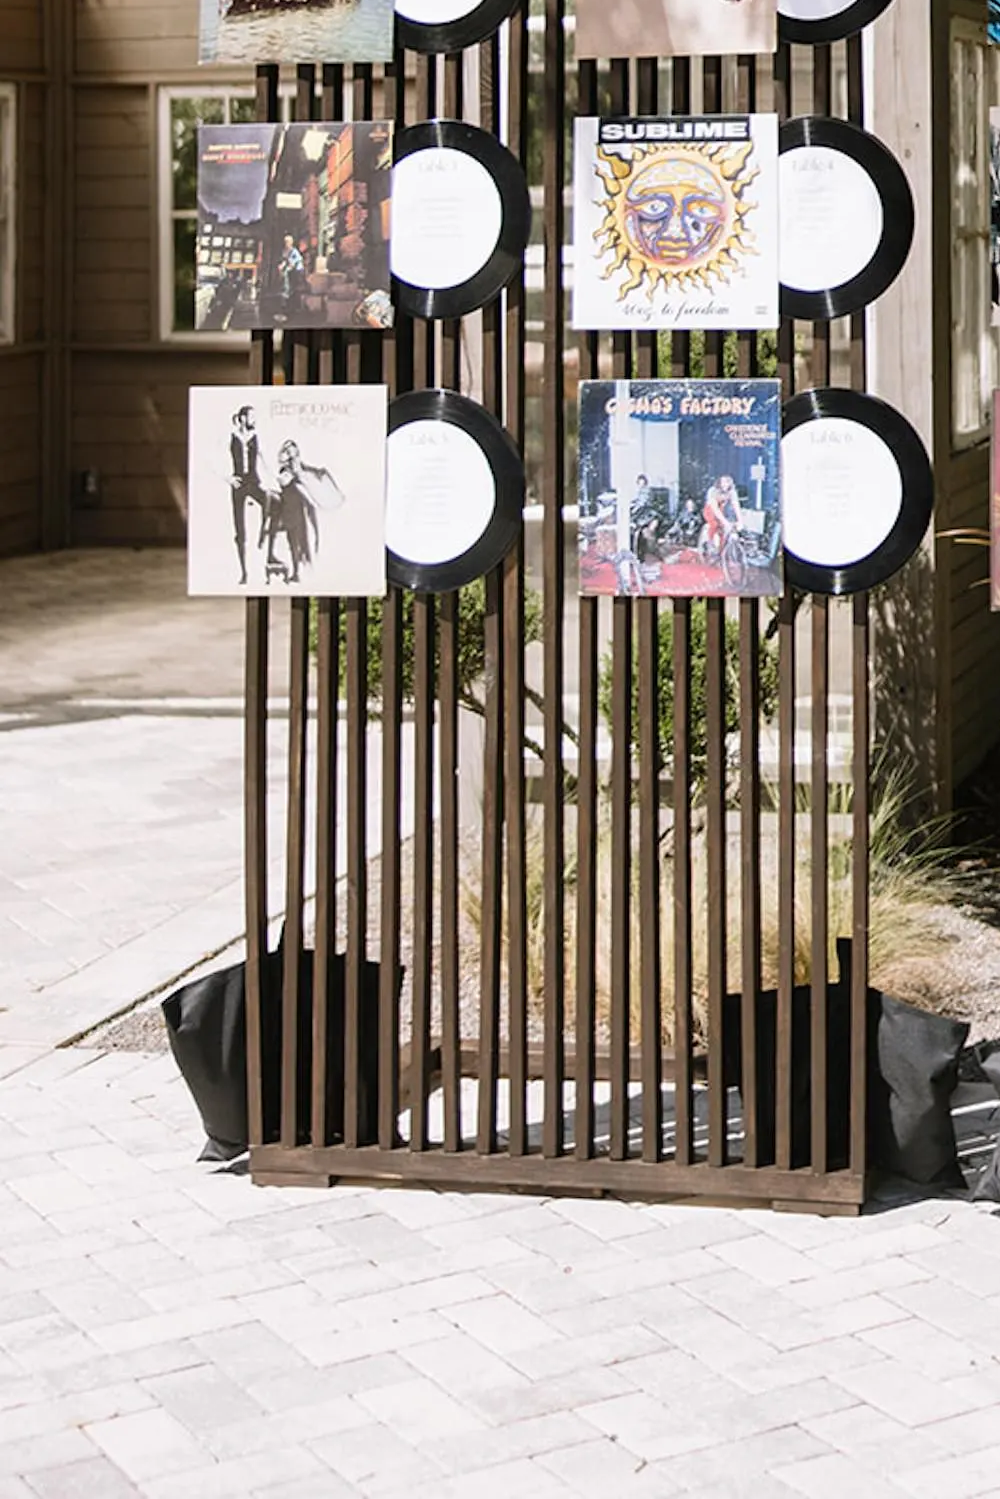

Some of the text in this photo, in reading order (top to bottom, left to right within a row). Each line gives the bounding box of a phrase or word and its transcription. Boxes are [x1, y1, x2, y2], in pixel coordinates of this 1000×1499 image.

[600, 123, 748, 142] SUBLIME
[605, 397, 756, 416] CSMO'S FACTORY
